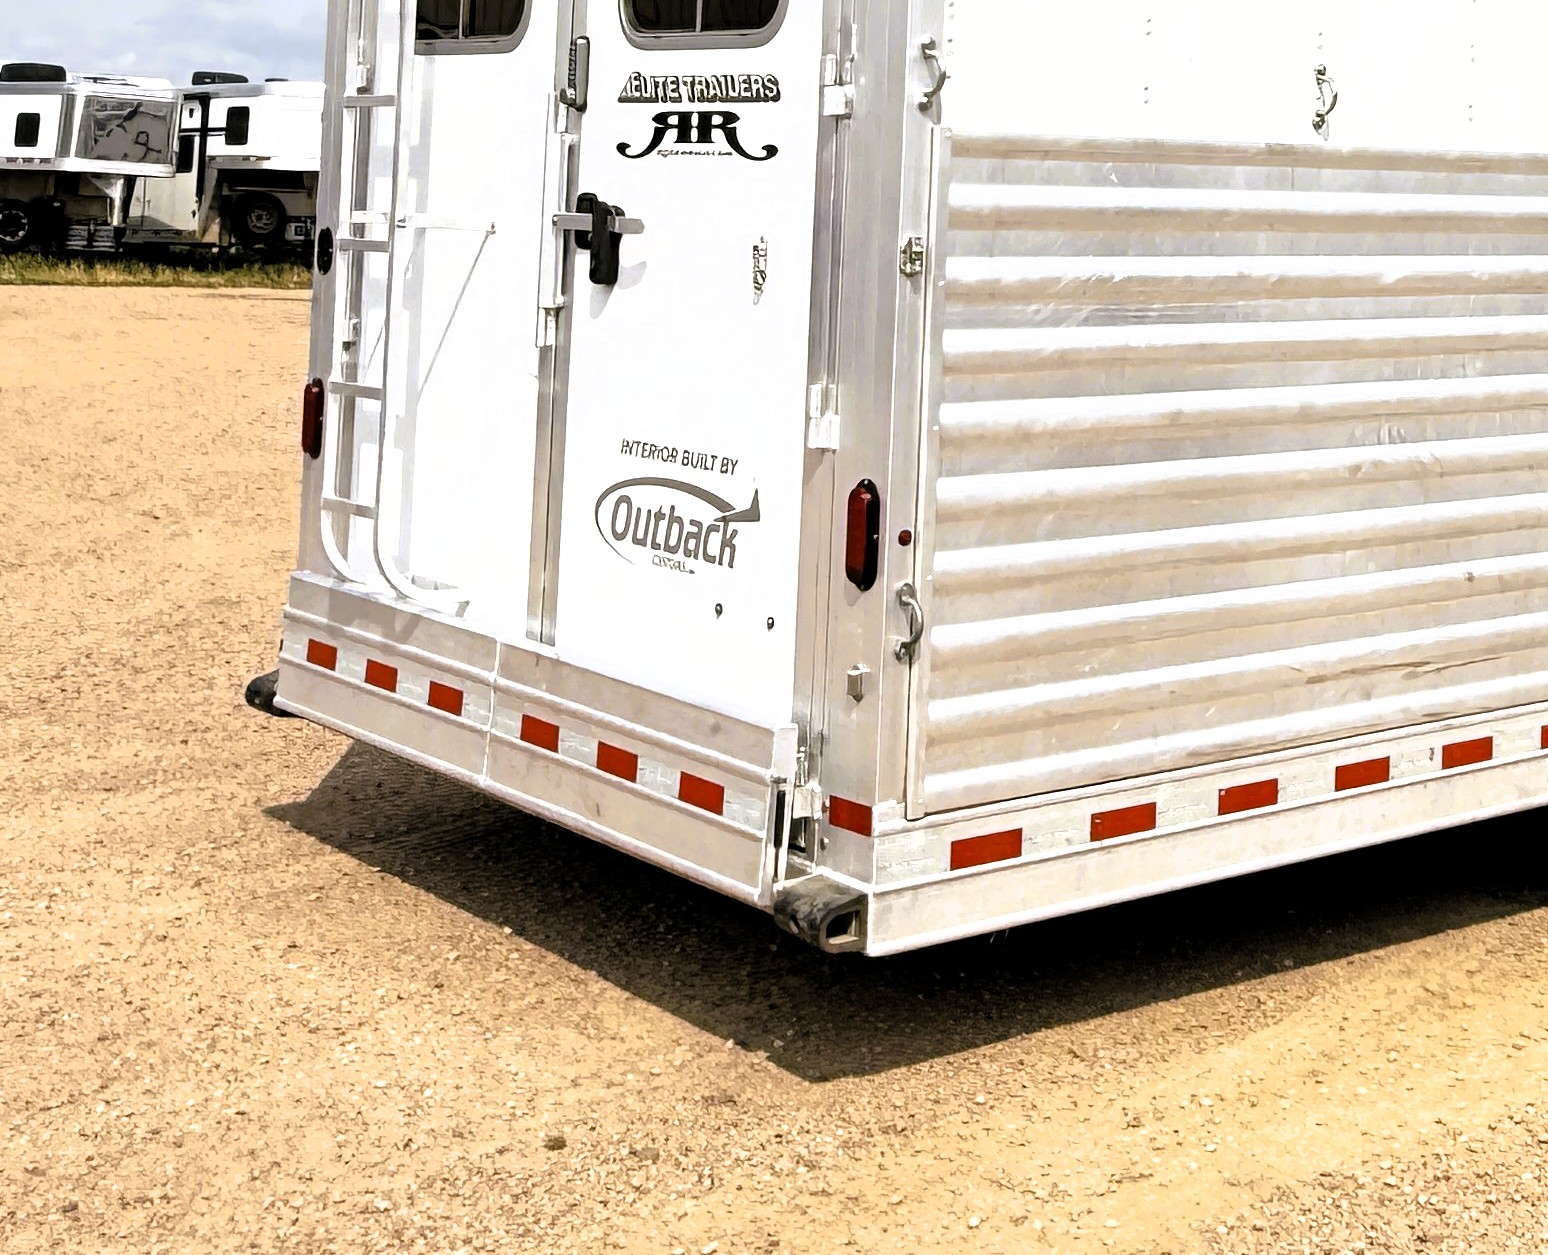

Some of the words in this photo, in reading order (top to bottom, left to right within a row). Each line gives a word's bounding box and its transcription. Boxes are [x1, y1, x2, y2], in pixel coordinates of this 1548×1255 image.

[617, 72, 683, 103] ELITE
[682, 74, 781, 103] TRAILERS
[621, 438, 679, 464] INTERIOR
[681, 450, 718, 472] BUILT
[720, 457, 739, 475] BY
[611, 495, 739, 569] Outback
